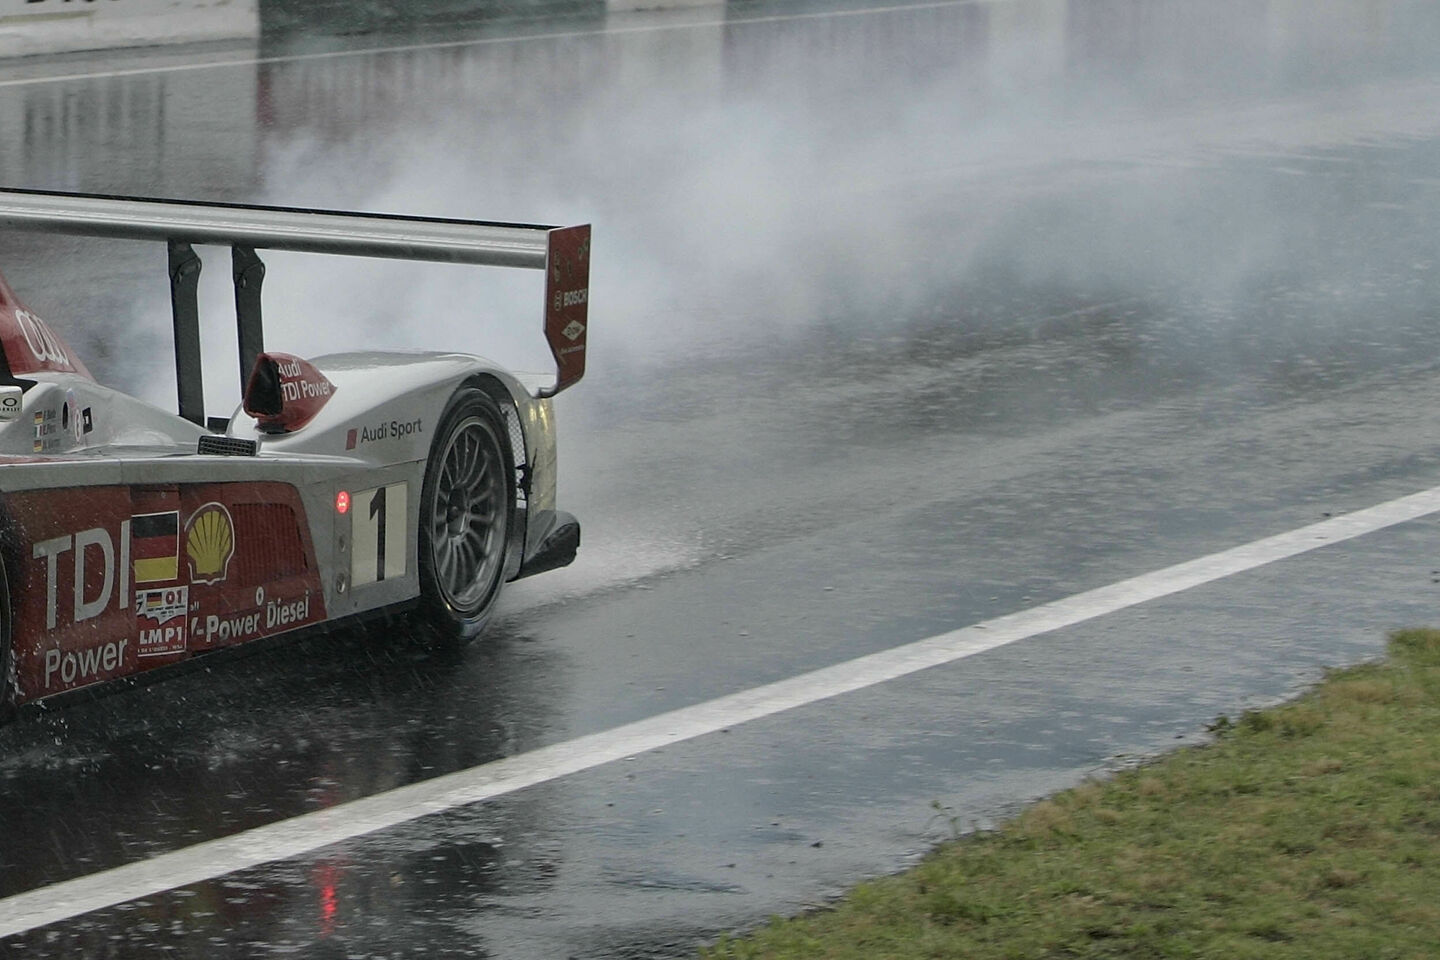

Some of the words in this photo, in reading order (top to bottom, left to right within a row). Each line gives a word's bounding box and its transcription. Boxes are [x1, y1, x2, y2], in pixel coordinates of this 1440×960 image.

[563, 288, 588, 307] BOSCH
[278, 359, 301, 378] Audi
[281, 382, 301, 402] TDI
[302, 381, 331, 398] Power
[361, 423, 388, 443] Audi
[390, 418, 423, 440] Sport
[369, 486, 386, 582] 1
[33, 520, 130, 630] TDI
[165, 590, 183, 605] 01
[266, 587, 310, 629] Diesel
[45, 639, 128, 688] Power
